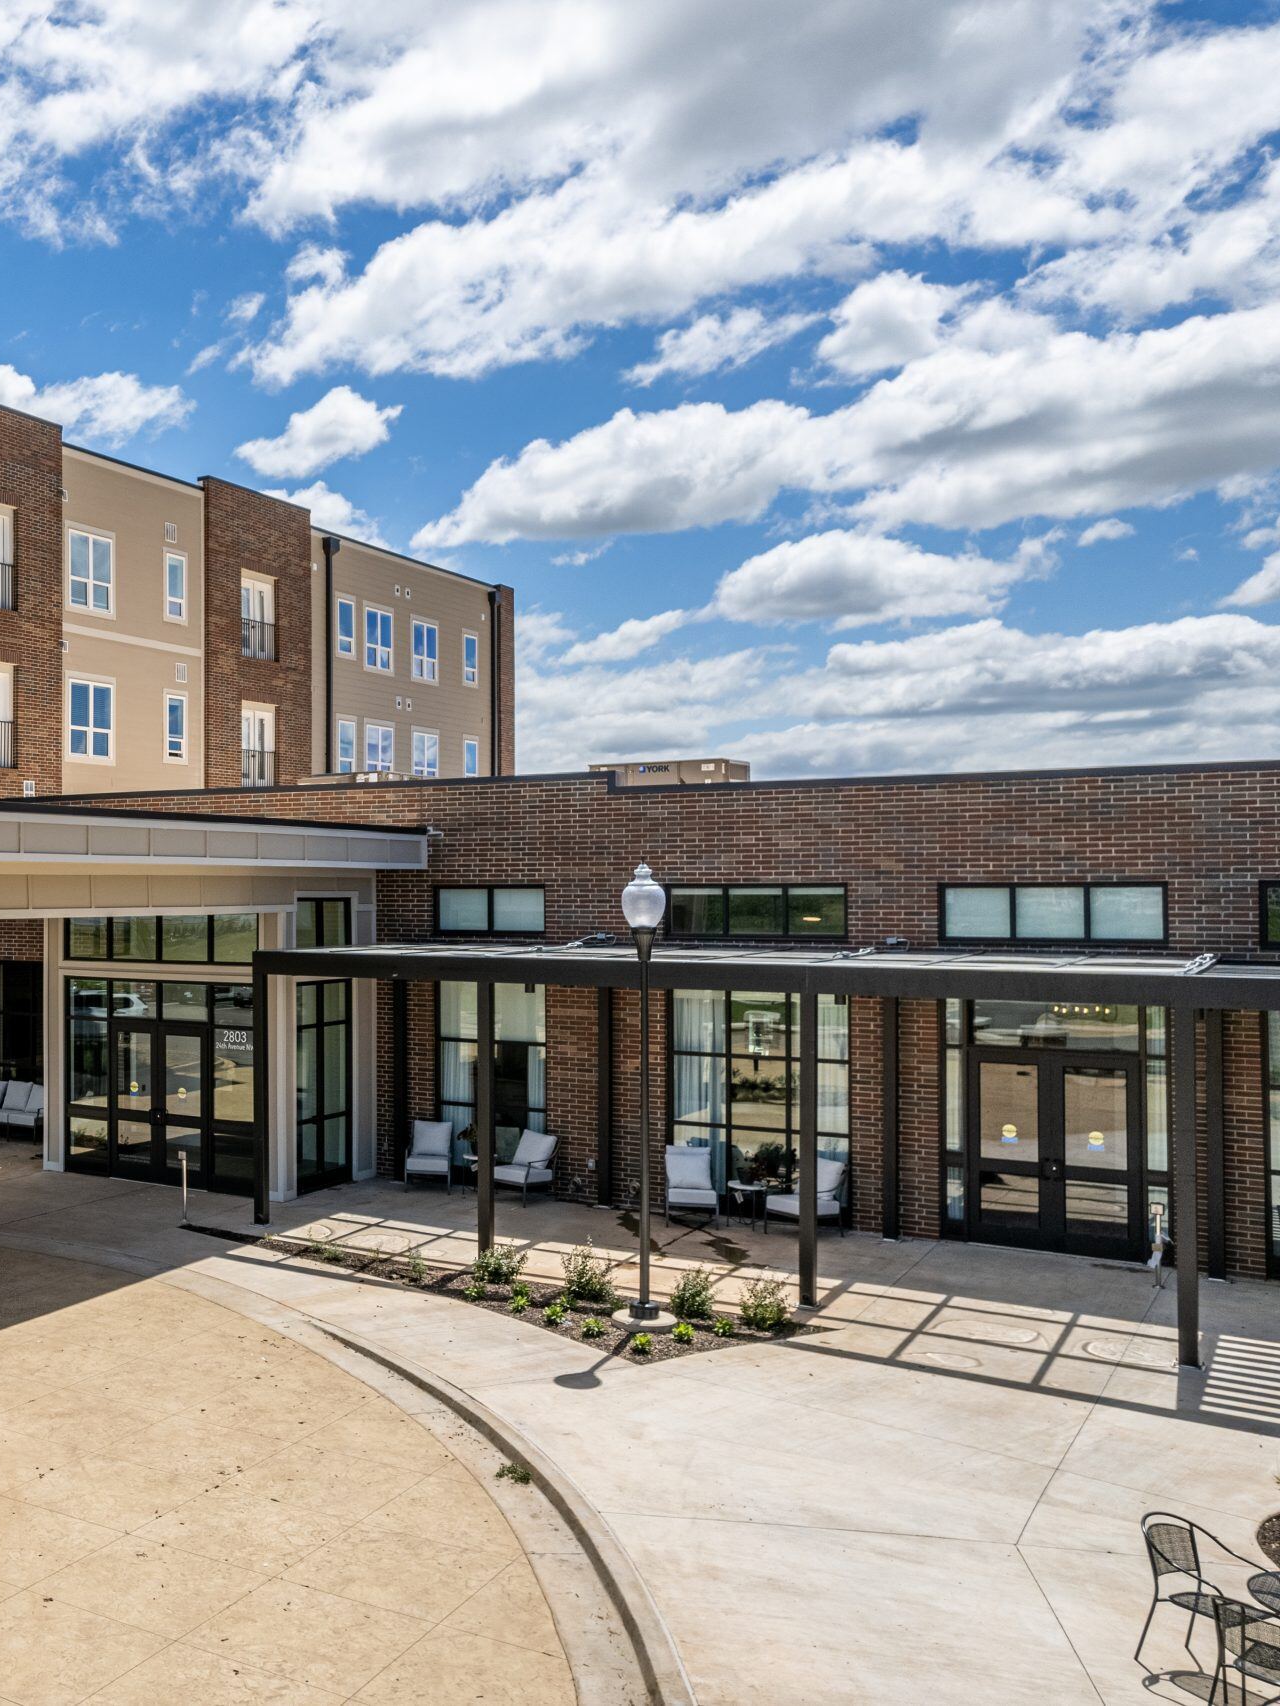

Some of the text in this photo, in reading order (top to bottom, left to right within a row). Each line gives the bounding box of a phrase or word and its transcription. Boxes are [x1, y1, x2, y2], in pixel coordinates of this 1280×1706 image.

[646, 765, 670, 773] YORK
[223, 1030, 247, 1043] 2803
[215, 1041, 227, 1049] 24th
[228, 1043, 245, 1051] Avenue
